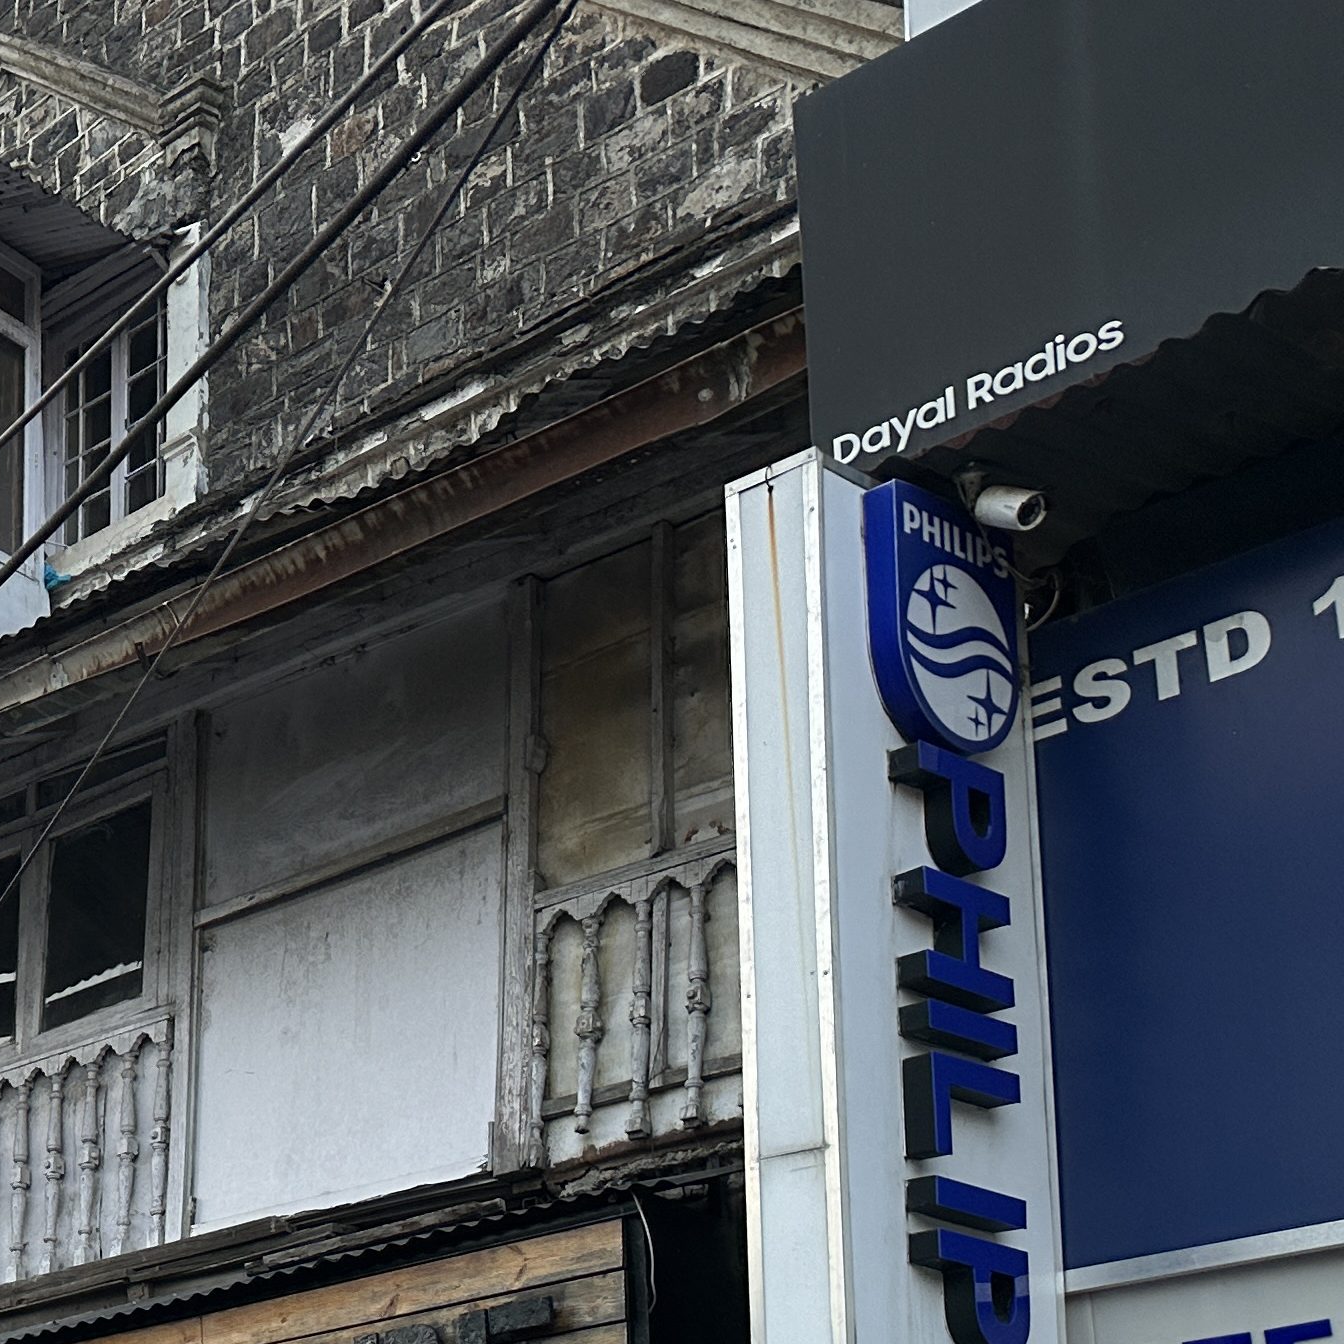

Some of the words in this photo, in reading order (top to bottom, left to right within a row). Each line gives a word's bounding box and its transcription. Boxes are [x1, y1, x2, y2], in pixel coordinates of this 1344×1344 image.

[832, 385, 957, 465] Dayal
[965, 318, 1125, 412] Radios
[902, 501, 1009, 578] PHILIPS
[1030, 610, 1272, 742] ESTD
